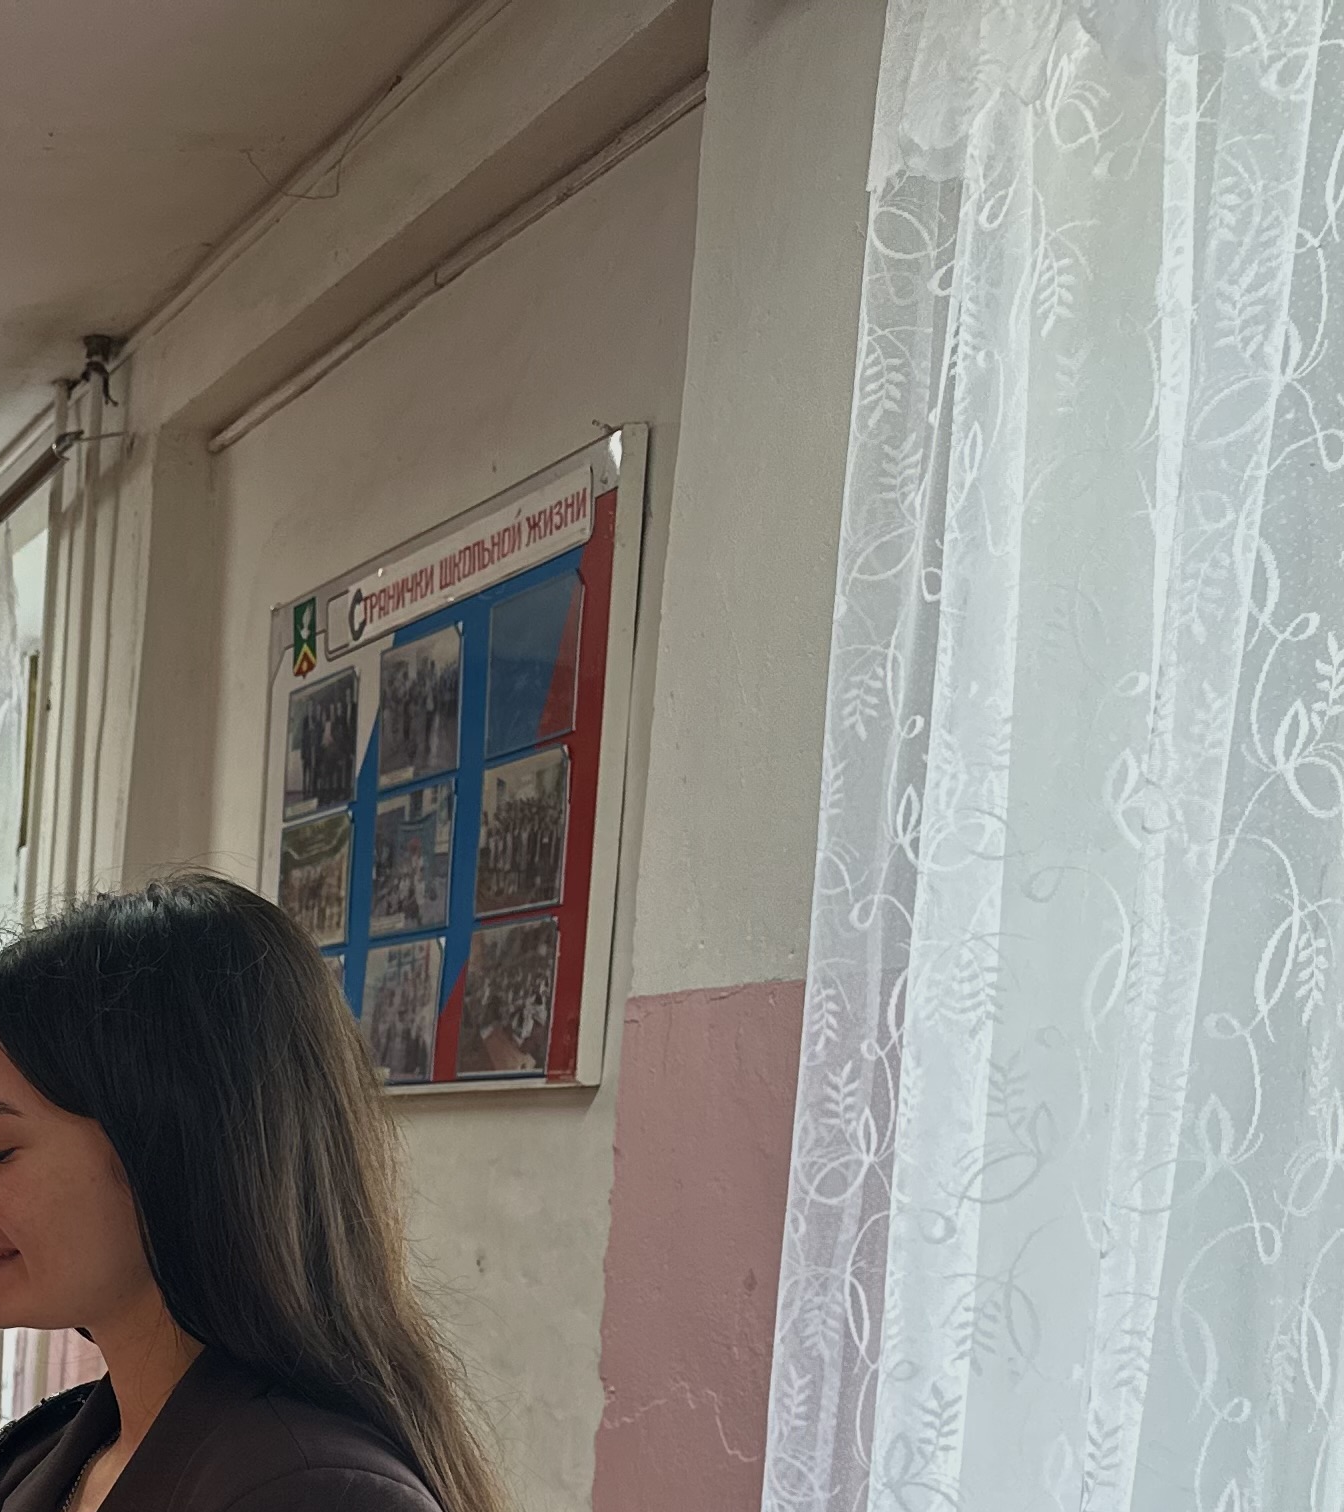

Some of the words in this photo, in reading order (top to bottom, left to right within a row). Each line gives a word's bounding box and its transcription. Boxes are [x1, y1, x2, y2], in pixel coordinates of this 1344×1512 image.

[348, 566, 434, 641] СТРАНИЧКИ
[439, 508, 522, 590] ШКОЛЬНОЙ
[525, 488, 587, 547] ЖИЗНИ
